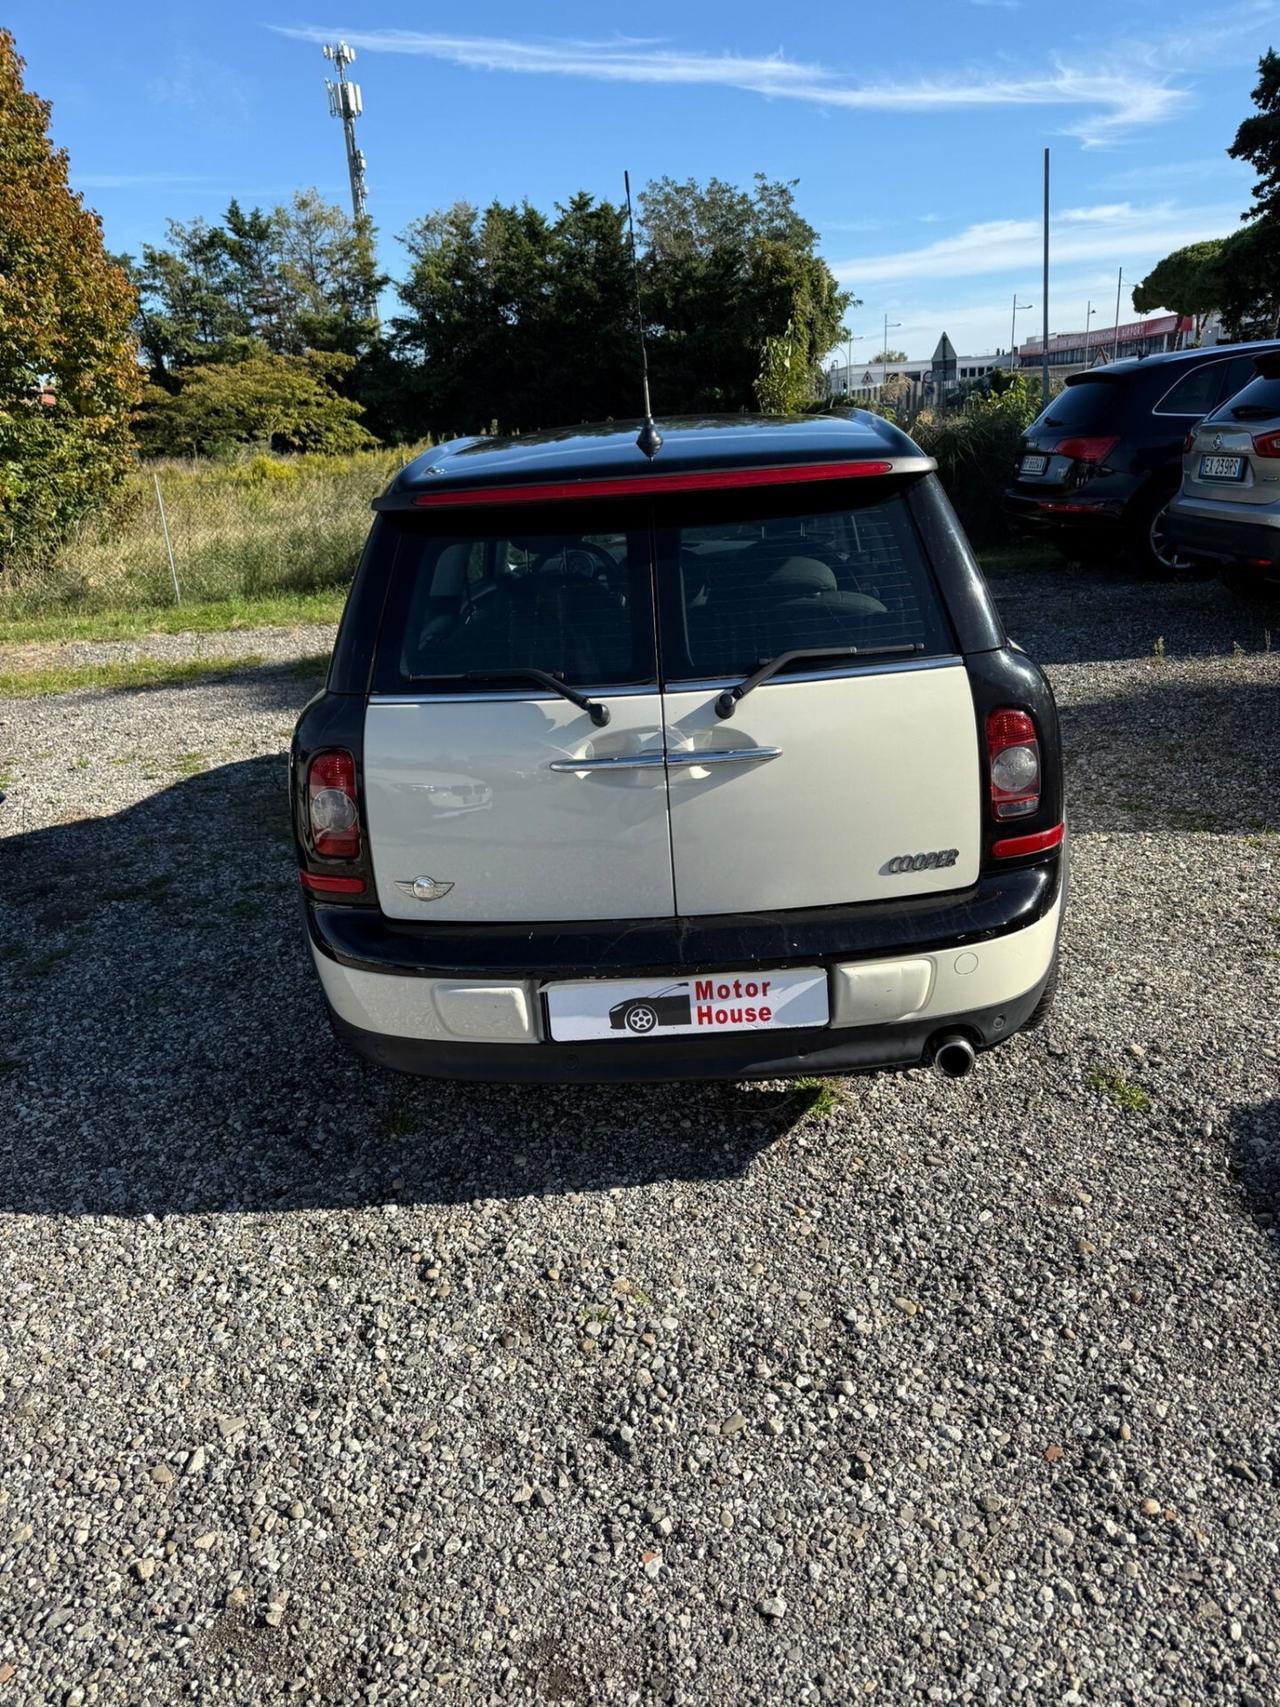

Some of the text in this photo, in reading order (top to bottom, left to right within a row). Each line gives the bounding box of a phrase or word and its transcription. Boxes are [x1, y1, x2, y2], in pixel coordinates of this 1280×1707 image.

[888, 849, 960, 873] COOPER
[694, 979, 772, 1001] Motor
[696, 1004, 772, 1025] House
